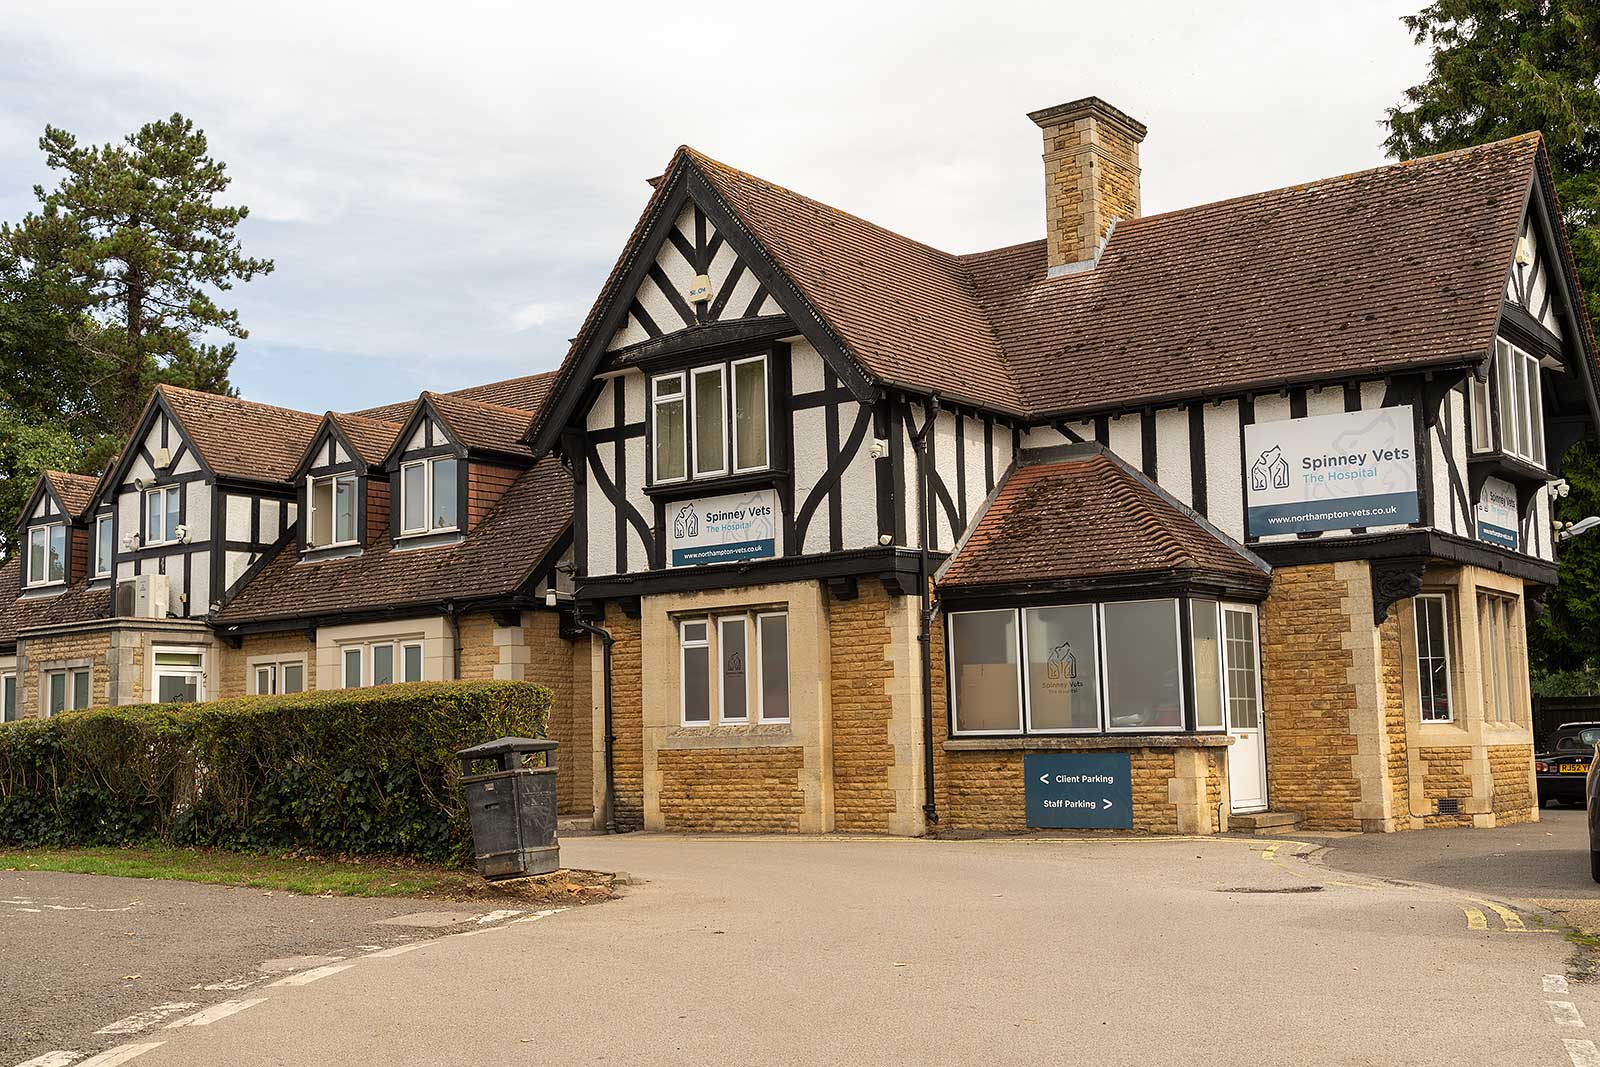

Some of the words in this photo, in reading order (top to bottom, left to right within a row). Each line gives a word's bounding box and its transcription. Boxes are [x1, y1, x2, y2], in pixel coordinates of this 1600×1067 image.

[1302, 453, 1367, 471] Spinney
[1372, 448, 1410, 462] Vets
[1303, 473, 1324, 484] The
[1328, 467, 1377, 481] Hospital
[706, 510, 746, 523] Spinney
[748, 506, 771, 517] Vets
[1268, 505, 1397, 525] www.northampton-vets.co.uk
[706, 525, 720, 533] The
[721, 521, 752, 532] Hospital
[684, 545, 763, 559] www.northampton-vets.co.uk
[1561, 764, 1581, 772] RJ52
[1055, 775, 1080, 783] Client
[1081, 775, 1114, 785] Parking
[1043, 800, 1063, 808] Staff
[1064, 800, 1097, 810] Parking
